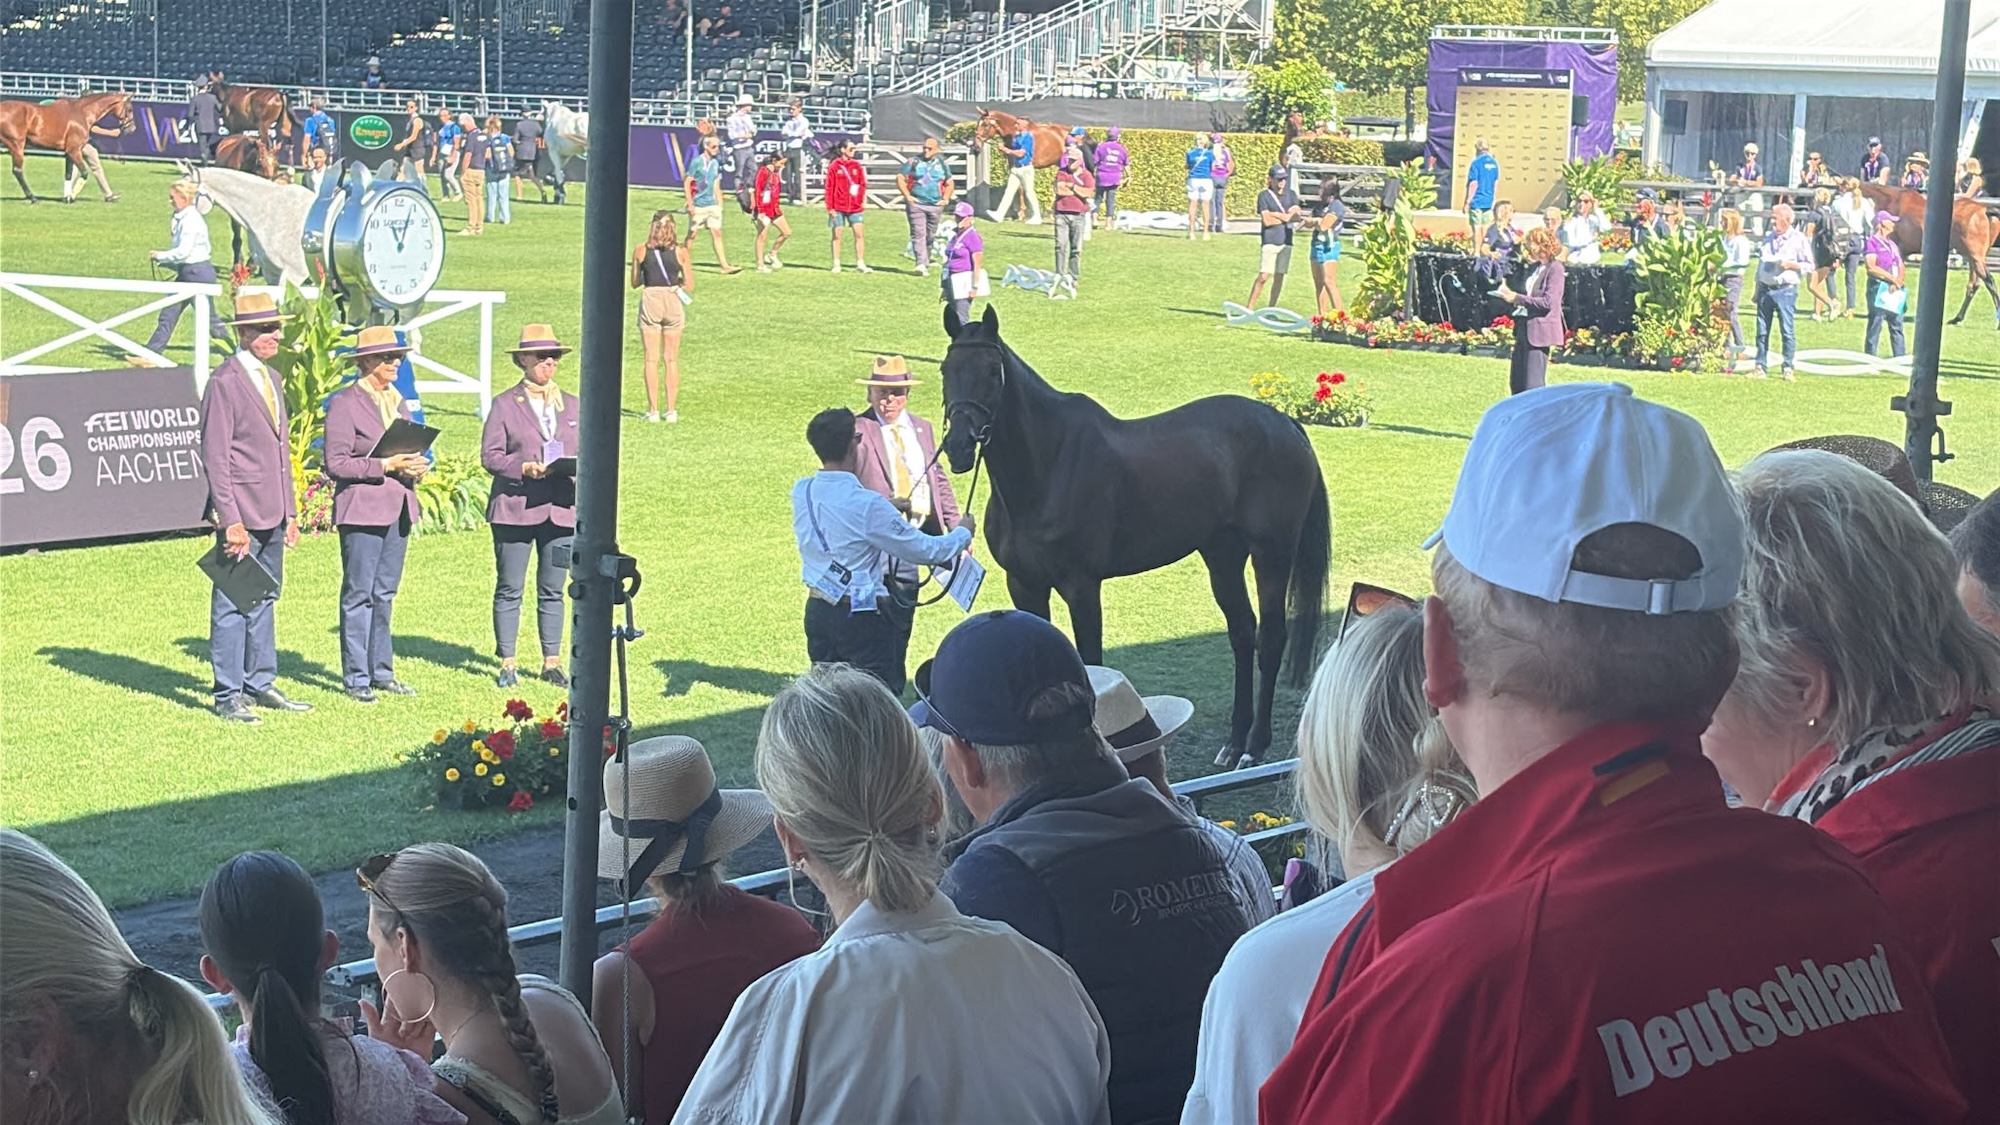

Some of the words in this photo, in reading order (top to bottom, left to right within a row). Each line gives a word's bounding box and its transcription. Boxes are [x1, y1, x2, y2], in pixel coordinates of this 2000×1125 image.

[394, 198, 405, 207] 12
[381, 204, 388, 214] 11
[370, 218, 380, 229] 10
[421, 218, 429, 228] 2
[424, 239, 433, 250] 3
[369, 263, 377, 274] 8
[420, 261, 428, 272] 4
[380, 279, 388, 290] 7
[409, 278, 418, 289] 5
[395, 284, 402, 295] 6
[84, 411, 129, 433] FEI
[131, 407, 200, 431] WORLD
[87, 429, 202, 452] CHAMPIONSHIPS
[97, 449, 203, 487] AACHEN
[1596, 943, 1903, 1097] Deutschland
